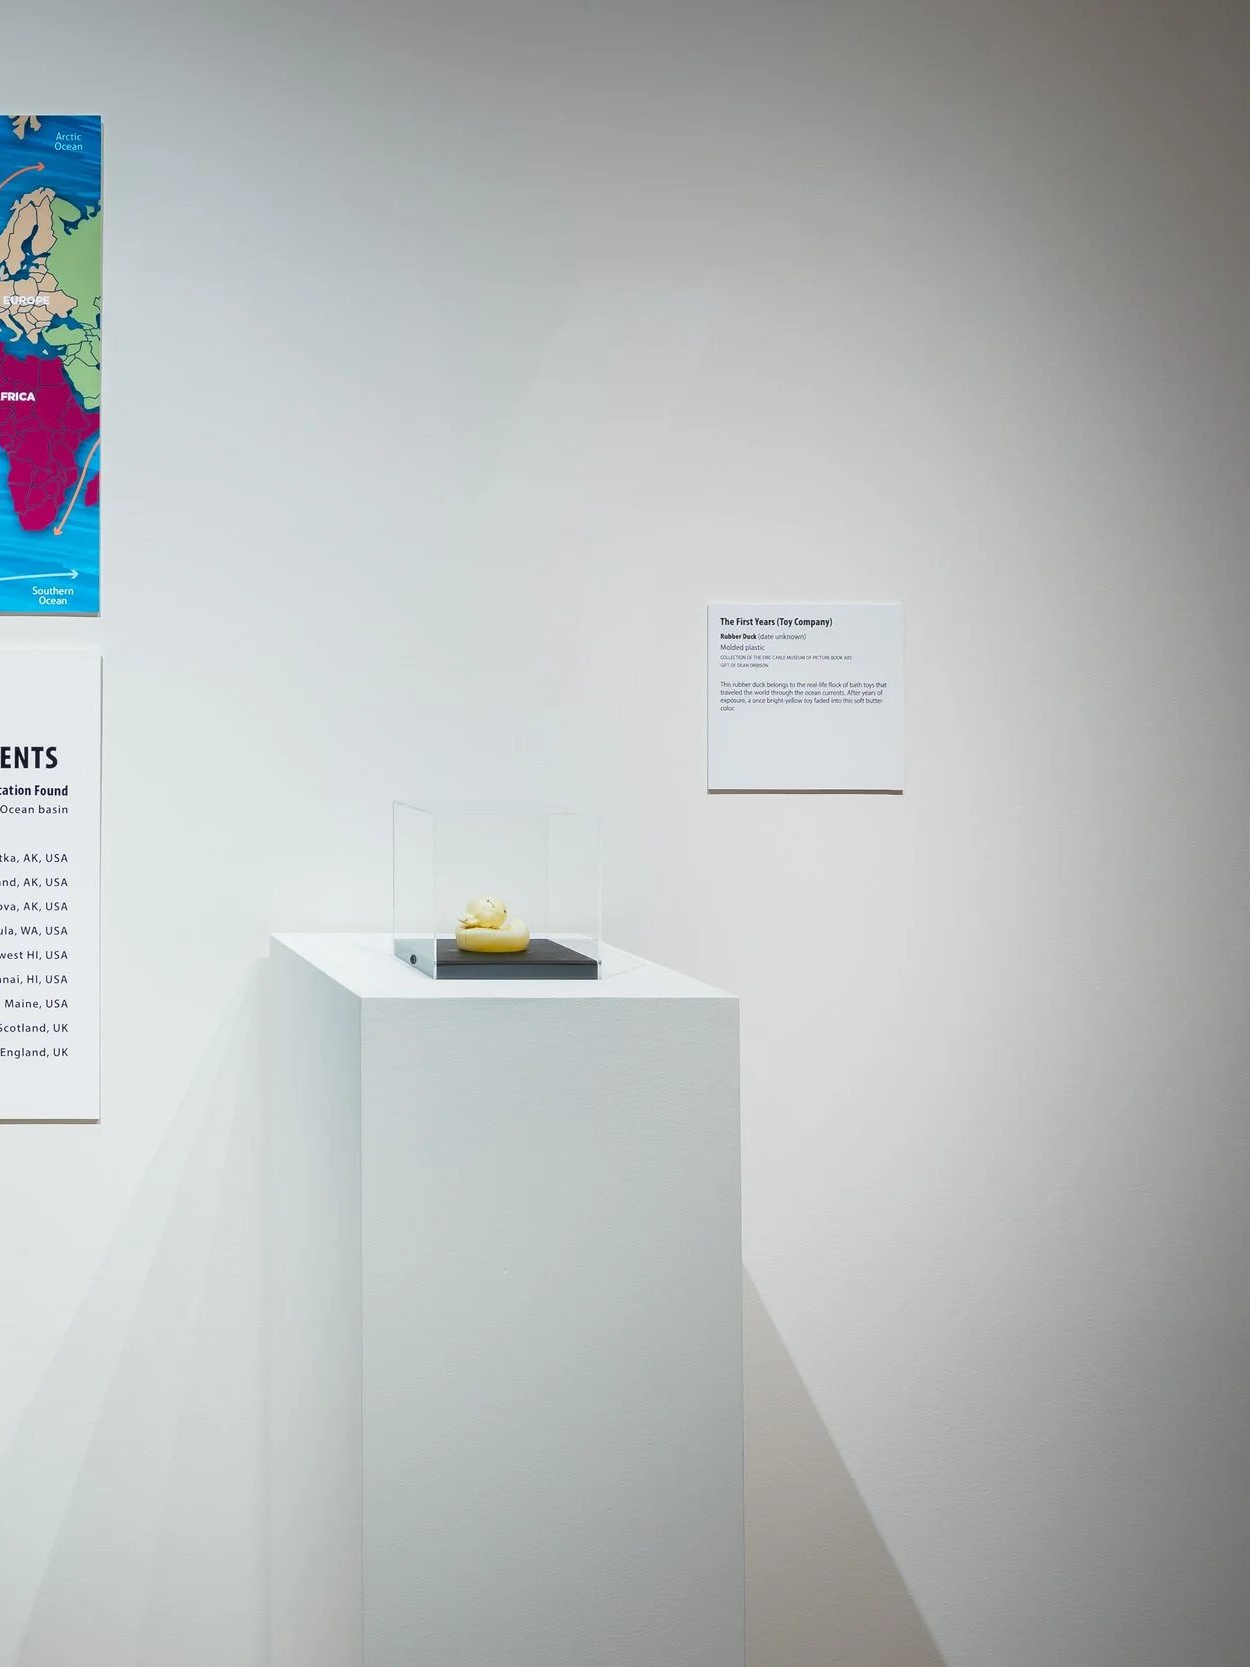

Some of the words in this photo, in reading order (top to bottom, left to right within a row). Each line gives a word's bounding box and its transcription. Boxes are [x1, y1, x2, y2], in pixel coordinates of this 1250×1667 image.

[55, 132, 81, 141] Arctic
[54, 142, 83, 151] Ocean
[3, 296, 50, 305] EUROPE
[32, 586, 74, 595] Southern
[38, 596, 67, 605] Ocean
[720, 617, 734, 626] The
[736, 617, 753, 626] First
[754, 618, 776, 626] Years
[776, 617, 793, 628] (Toy
[794, 617, 833, 628] Company)
[758, 633, 774, 641] (date
[775, 633, 806, 641] unknown)
[34, 785, 68, 796] Found
[0, 804, 35, 814] Ocean
[38, 804, 68, 814] basin
[23, 853, 42, 864] AK,
[45, 853, 68, 863] USA
[20, 926, 42, 936] WA,
[45, 926, 68, 936] USA
[27, 975, 42, 985] HI,
[45, 974, 68, 984] USA
[0, 1047, 49, 1059] England,
[53, 1048, 68, 1057] UK
